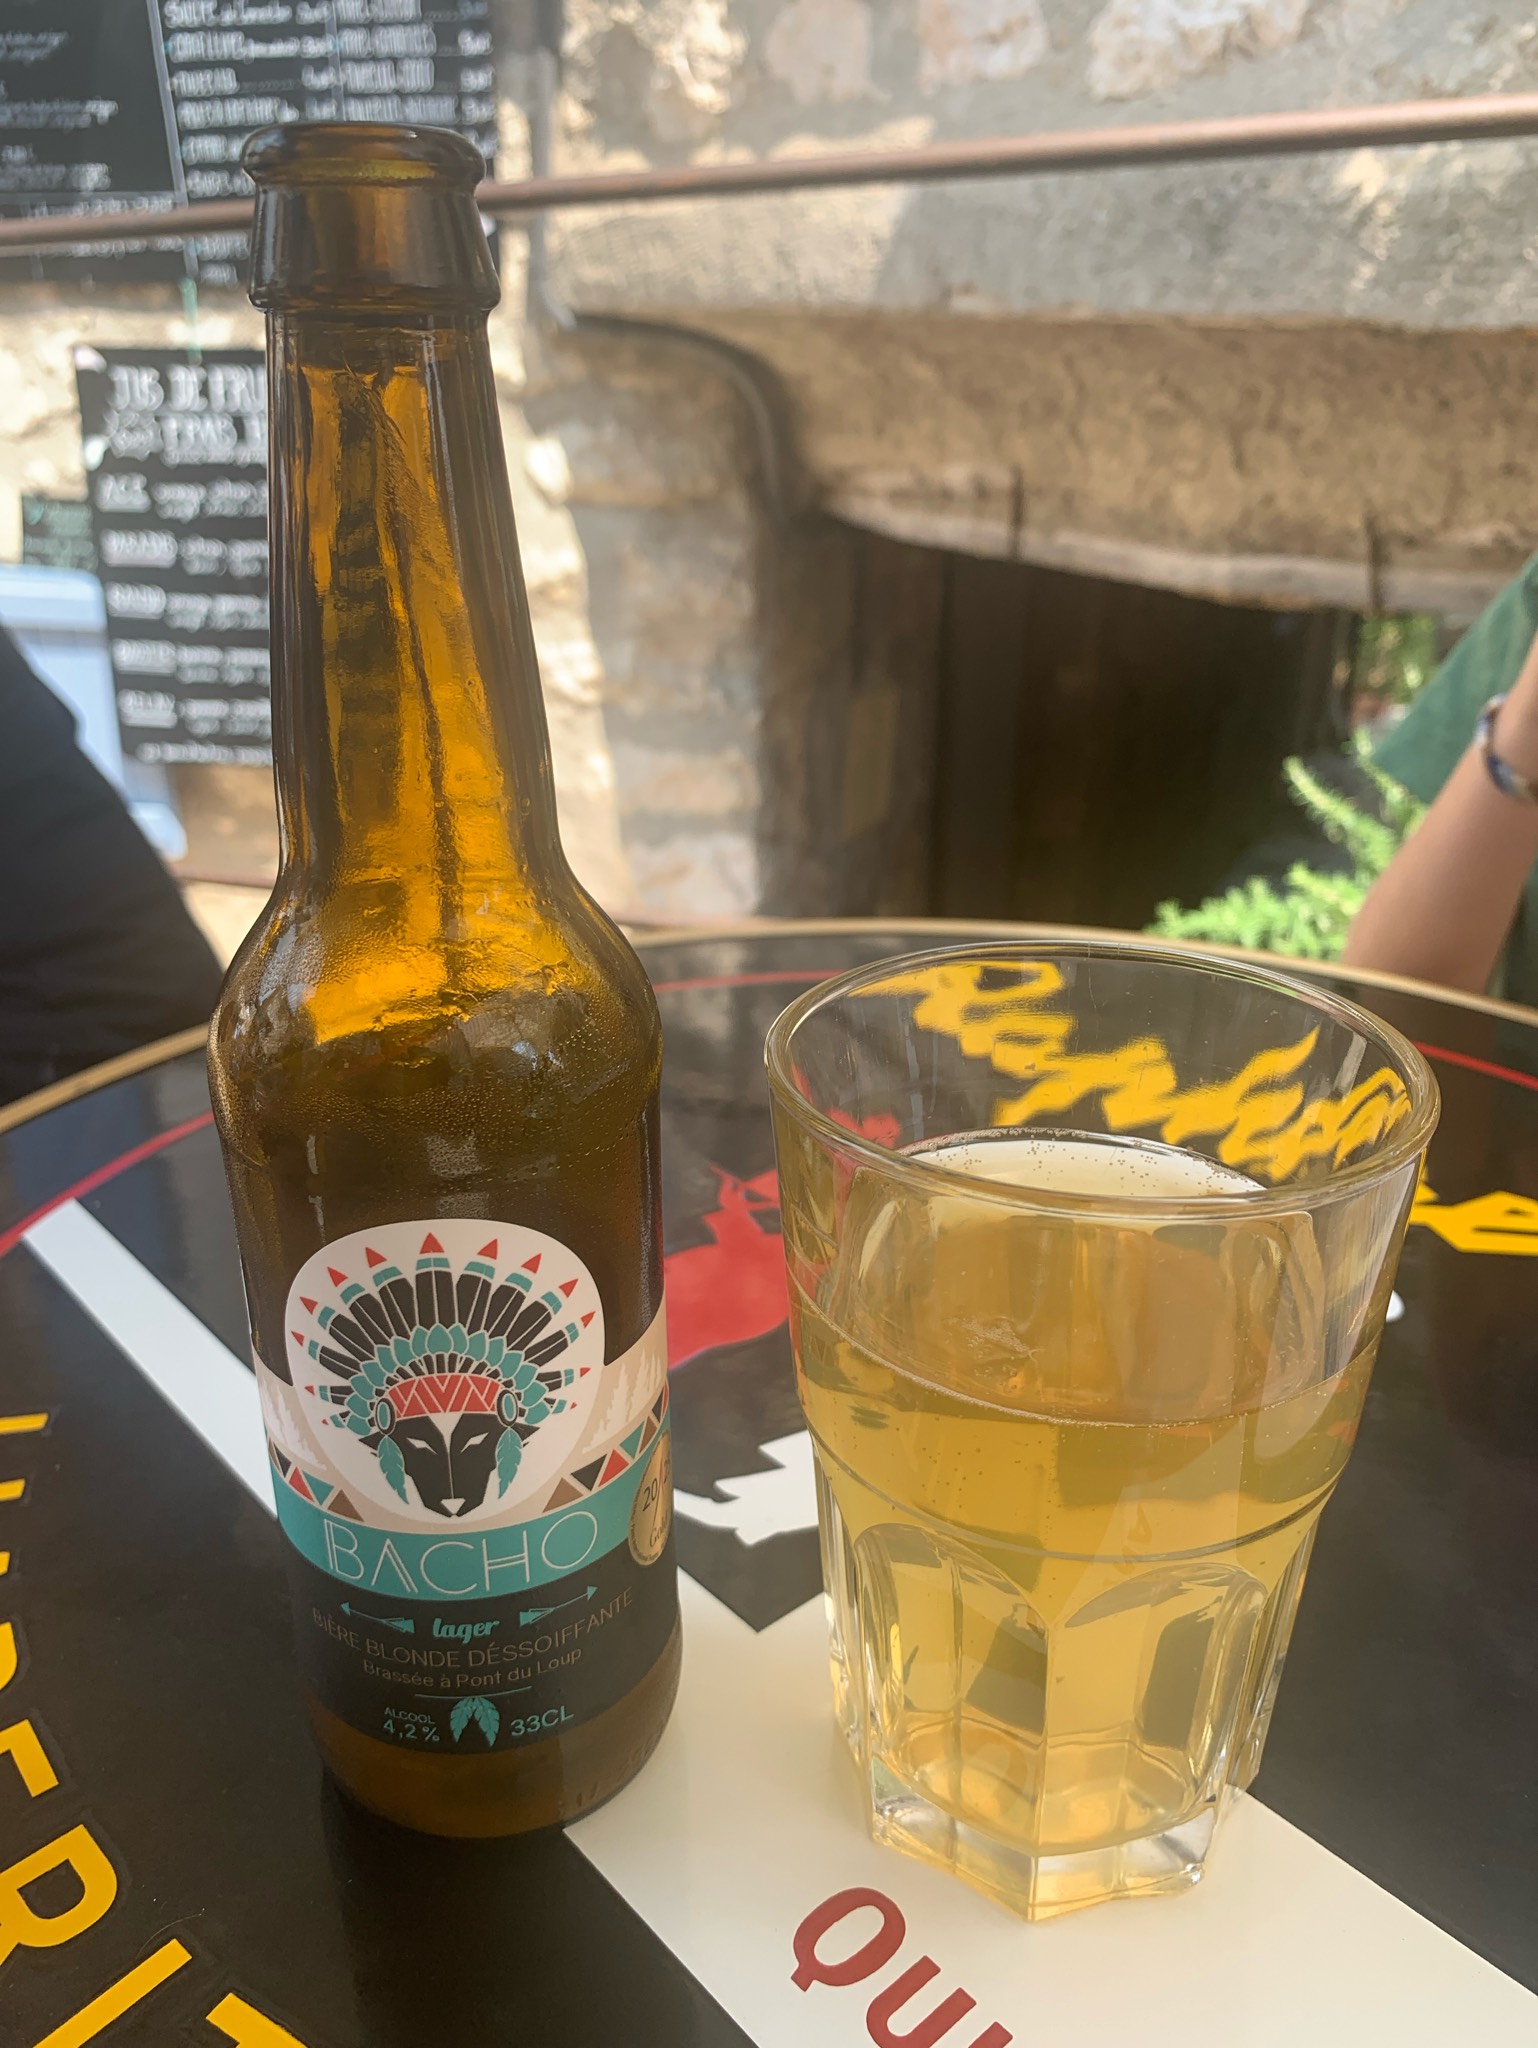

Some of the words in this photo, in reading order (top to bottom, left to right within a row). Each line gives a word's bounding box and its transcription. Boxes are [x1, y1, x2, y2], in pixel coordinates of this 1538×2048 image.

[324, 1510, 598, 1594] BACHO
[312, 1607, 362, 1651] BIÈRE
[365, 1637, 461, 1668] BLONDE
[468, 1585, 633, 1668] DÉSSOIFFANTE
[432, 1617, 501, 1645] lager
[363, 1658, 434, 1687] Brassée
[440, 1674, 451, 1688] à
[456, 1671, 502, 1689] Pont
[507, 1666, 532, 1681] du
[537, 1648, 582, 1675] Loup
[384, 1706, 436, 1725] ALCOOL
[510, 1705, 575, 1737] 33CL
